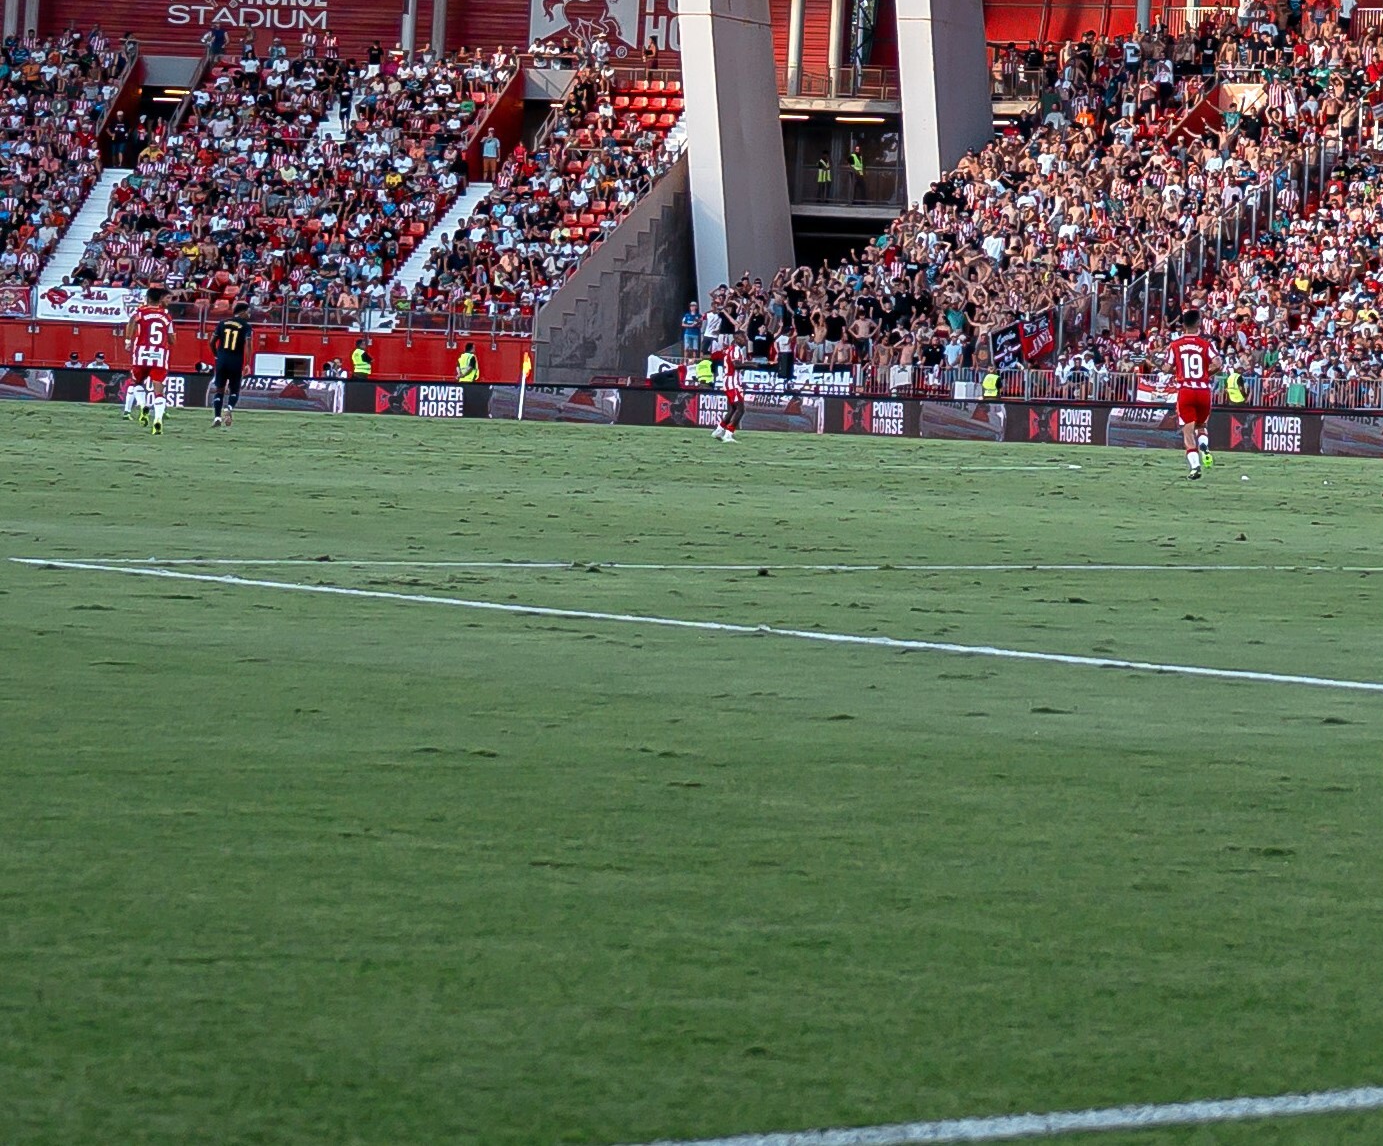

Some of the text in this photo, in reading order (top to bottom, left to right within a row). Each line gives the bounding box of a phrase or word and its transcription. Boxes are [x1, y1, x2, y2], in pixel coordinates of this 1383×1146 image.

[168, 5, 327, 29] STADIUM
[149, 322, 163, 345] 5
[223, 329, 239, 351] 11
[1180, 353, 1203, 379] 19
[419, 386, 464, 401] POWER
[699, 394, 728, 410] POWER
[418, 401, 464, 417] HORSE
[872, 402, 904, 418] POWER
[1059, 408, 1092, 425] POWER
[872, 418, 904, 435] HORSE
[1264, 415, 1301, 434] POWER
[1059, 426, 1092, 443] HORSE
[1264, 433, 1301, 452] HORSE
